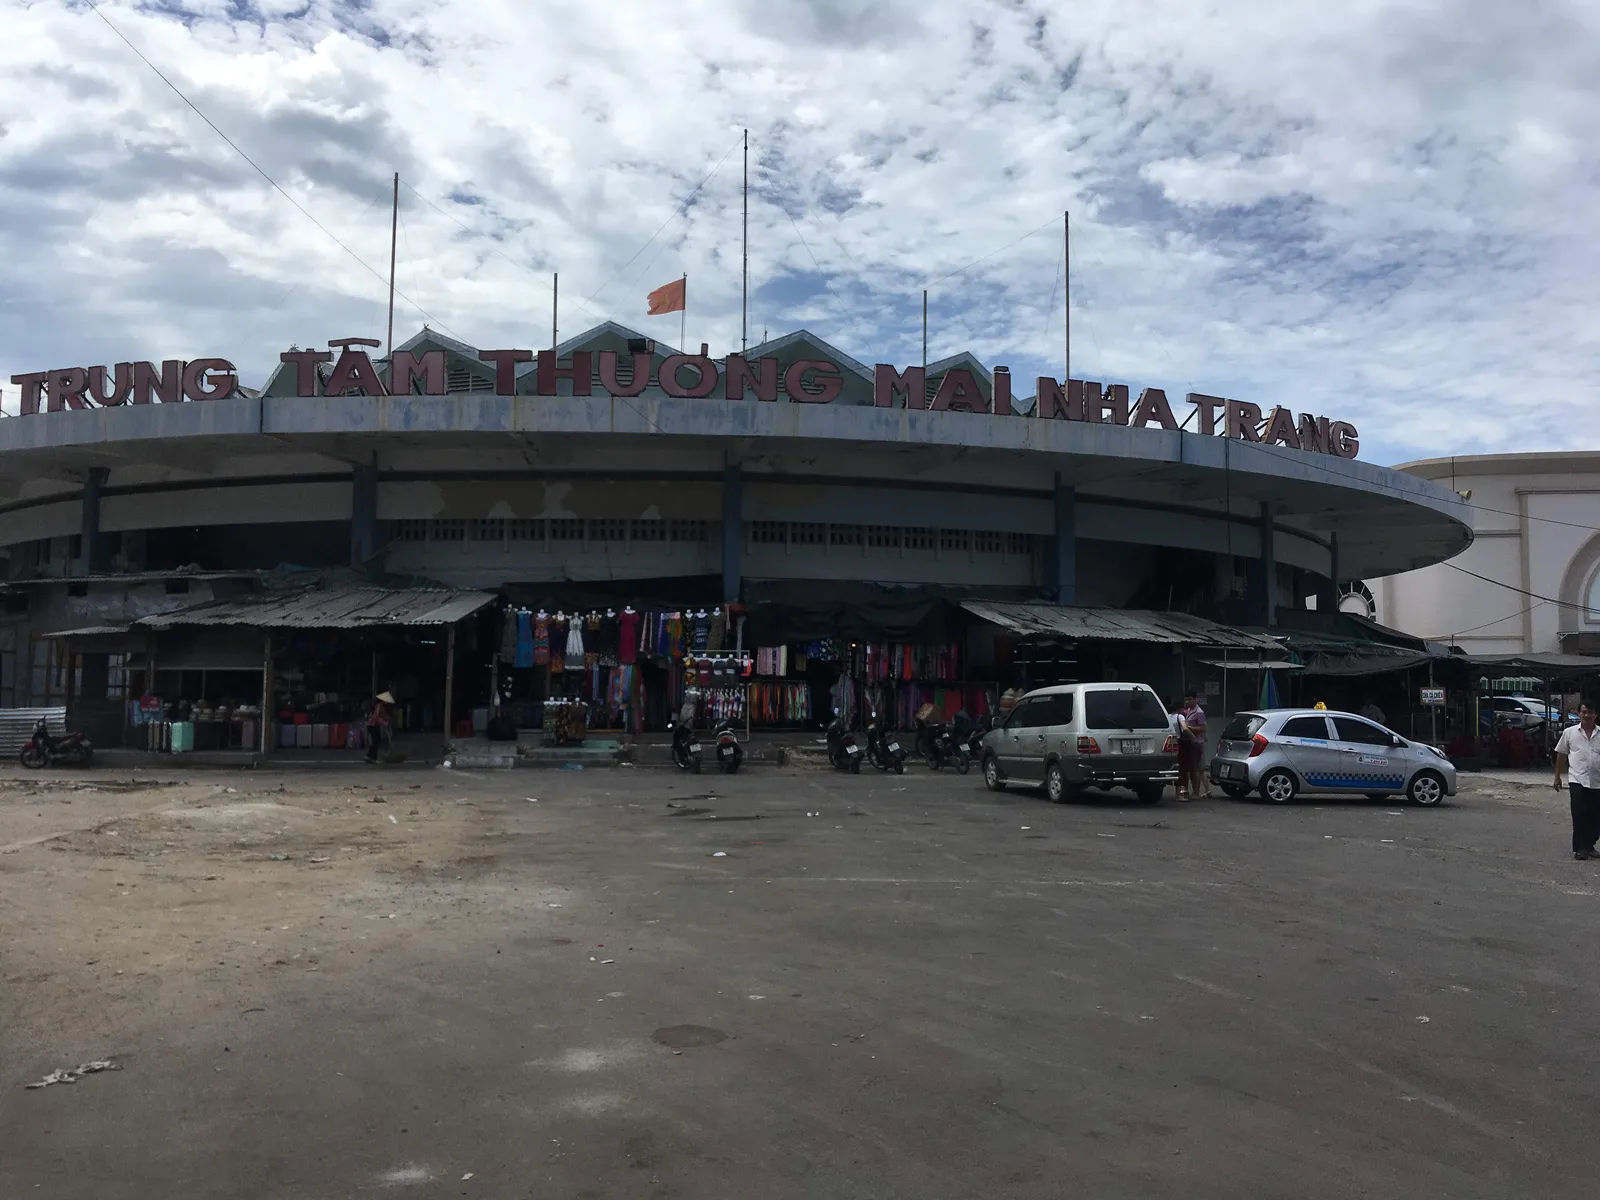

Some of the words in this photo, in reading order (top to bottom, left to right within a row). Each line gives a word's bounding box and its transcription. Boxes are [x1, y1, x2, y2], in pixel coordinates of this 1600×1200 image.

[11, 358, 238, 416] TRUNG
[280, 337, 449, 397] TÂM
[1036, 376, 1179, 430] NHA
[1186, 393, 1360, 459] TRANG
